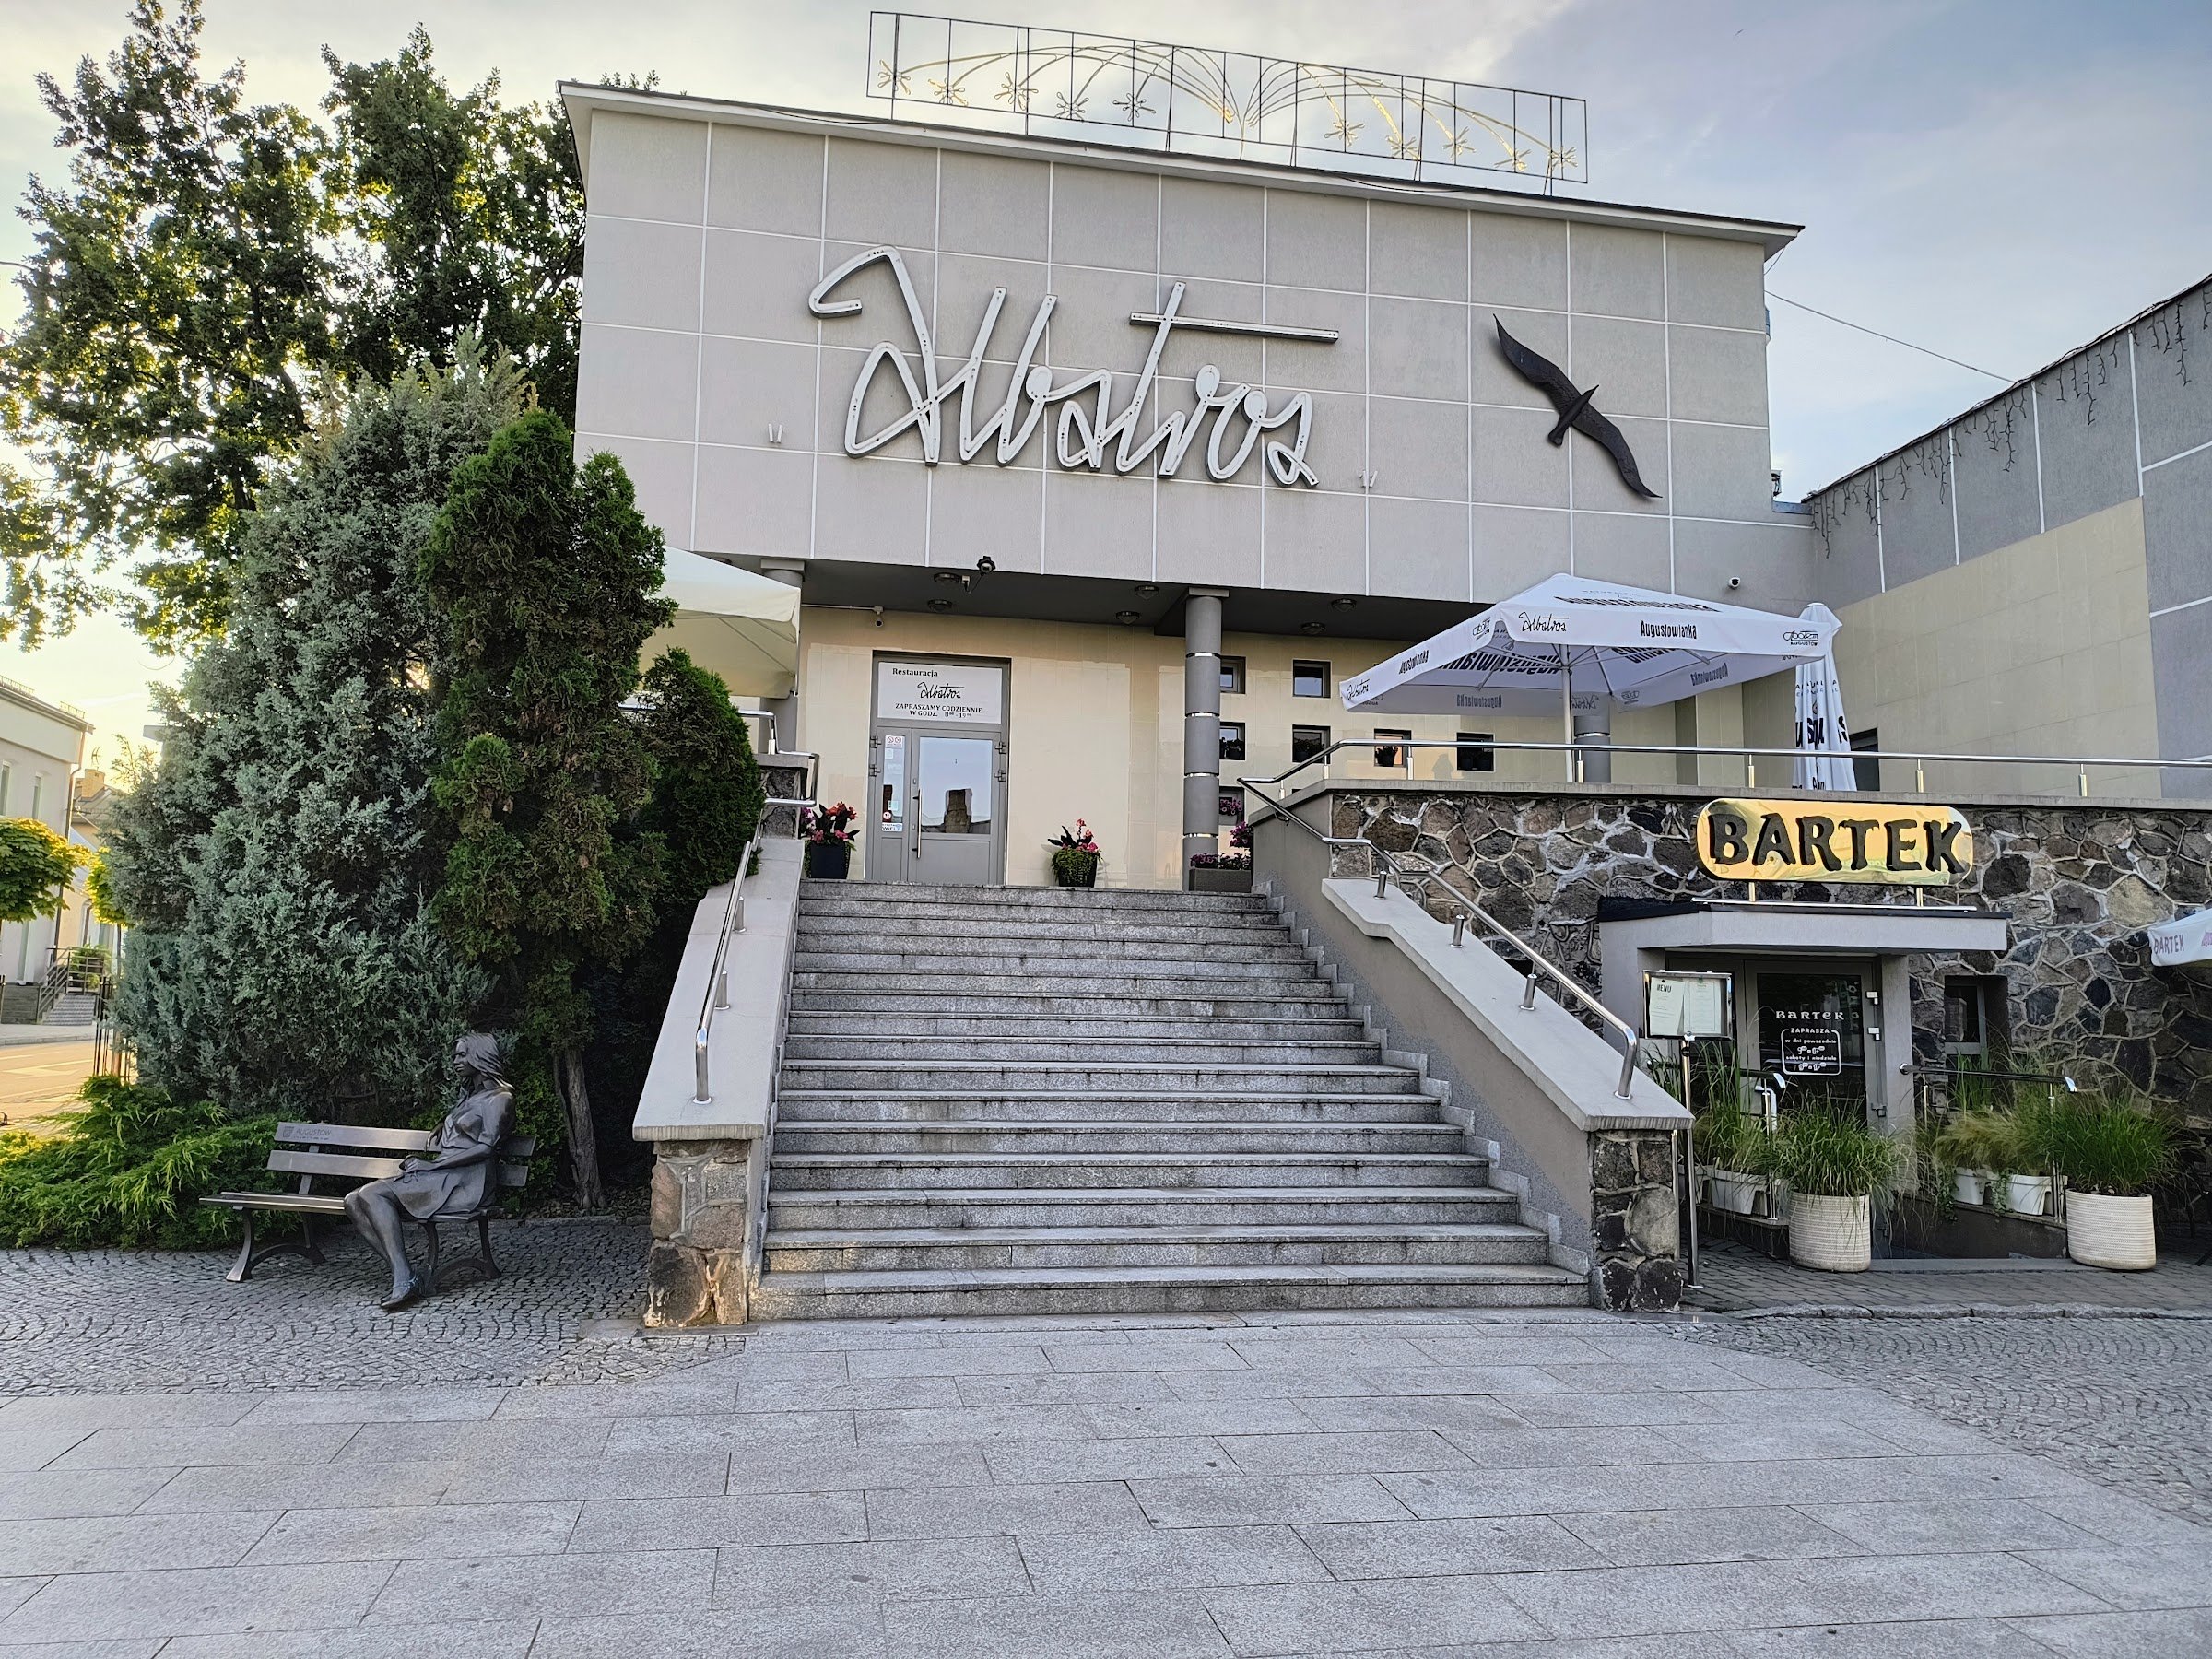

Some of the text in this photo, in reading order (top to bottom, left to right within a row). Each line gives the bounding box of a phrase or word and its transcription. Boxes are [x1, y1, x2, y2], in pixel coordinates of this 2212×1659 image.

[808, 244, 1338, 488] Albatros
[1518, 611, 1569, 632] Albatros
[892, 668, 938, 677] Restauracja
[917, 682, 965, 699] Albatros
[942, 705, 982, 713] CODZIENNIE
[1707, 813, 1967, 874] BARTEK
[2154, 934, 2184, 955] BARTEK
